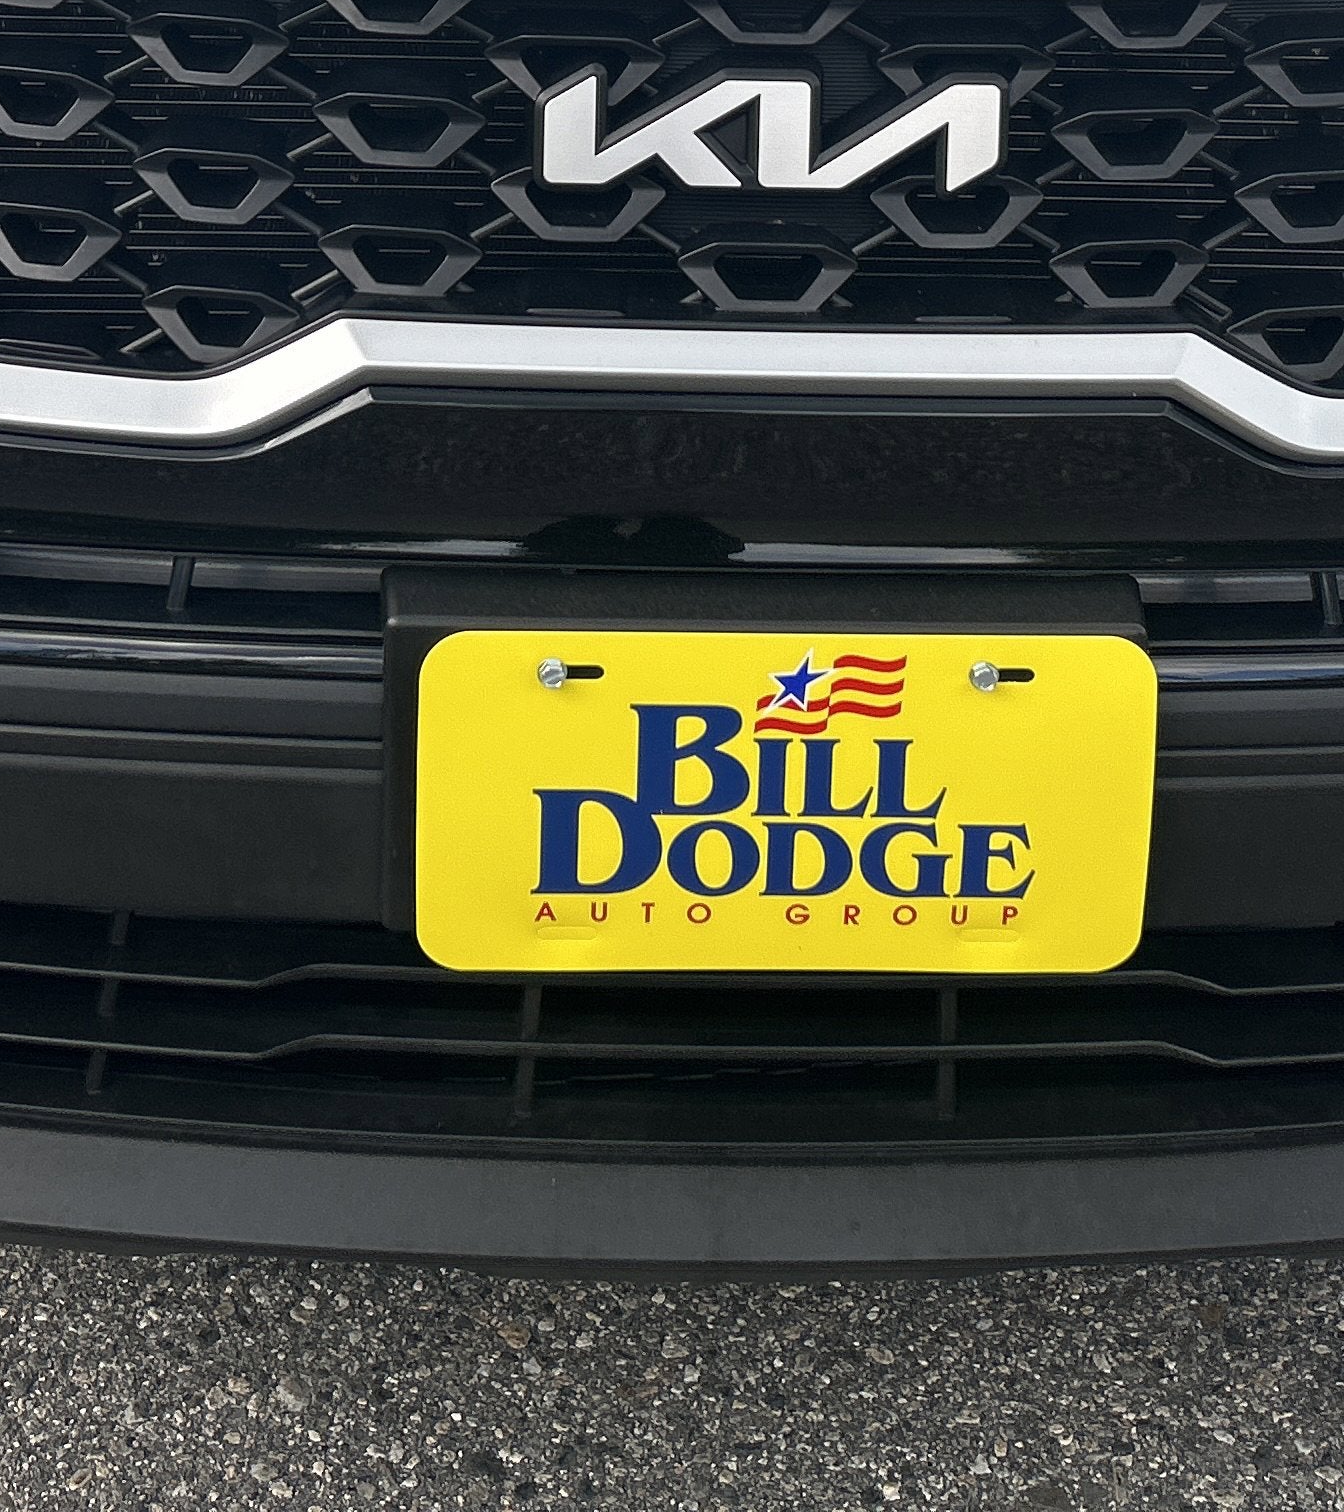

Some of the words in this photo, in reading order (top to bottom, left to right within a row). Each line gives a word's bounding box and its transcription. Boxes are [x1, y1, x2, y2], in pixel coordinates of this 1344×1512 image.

[543, 75, 1002, 192] KIA
[630, 703, 947, 818] BILL
[531, 788, 1035, 899] DODGE
[534, 901, 713, 925] AUTO
[784, 903, 1019, 926] GROUP
